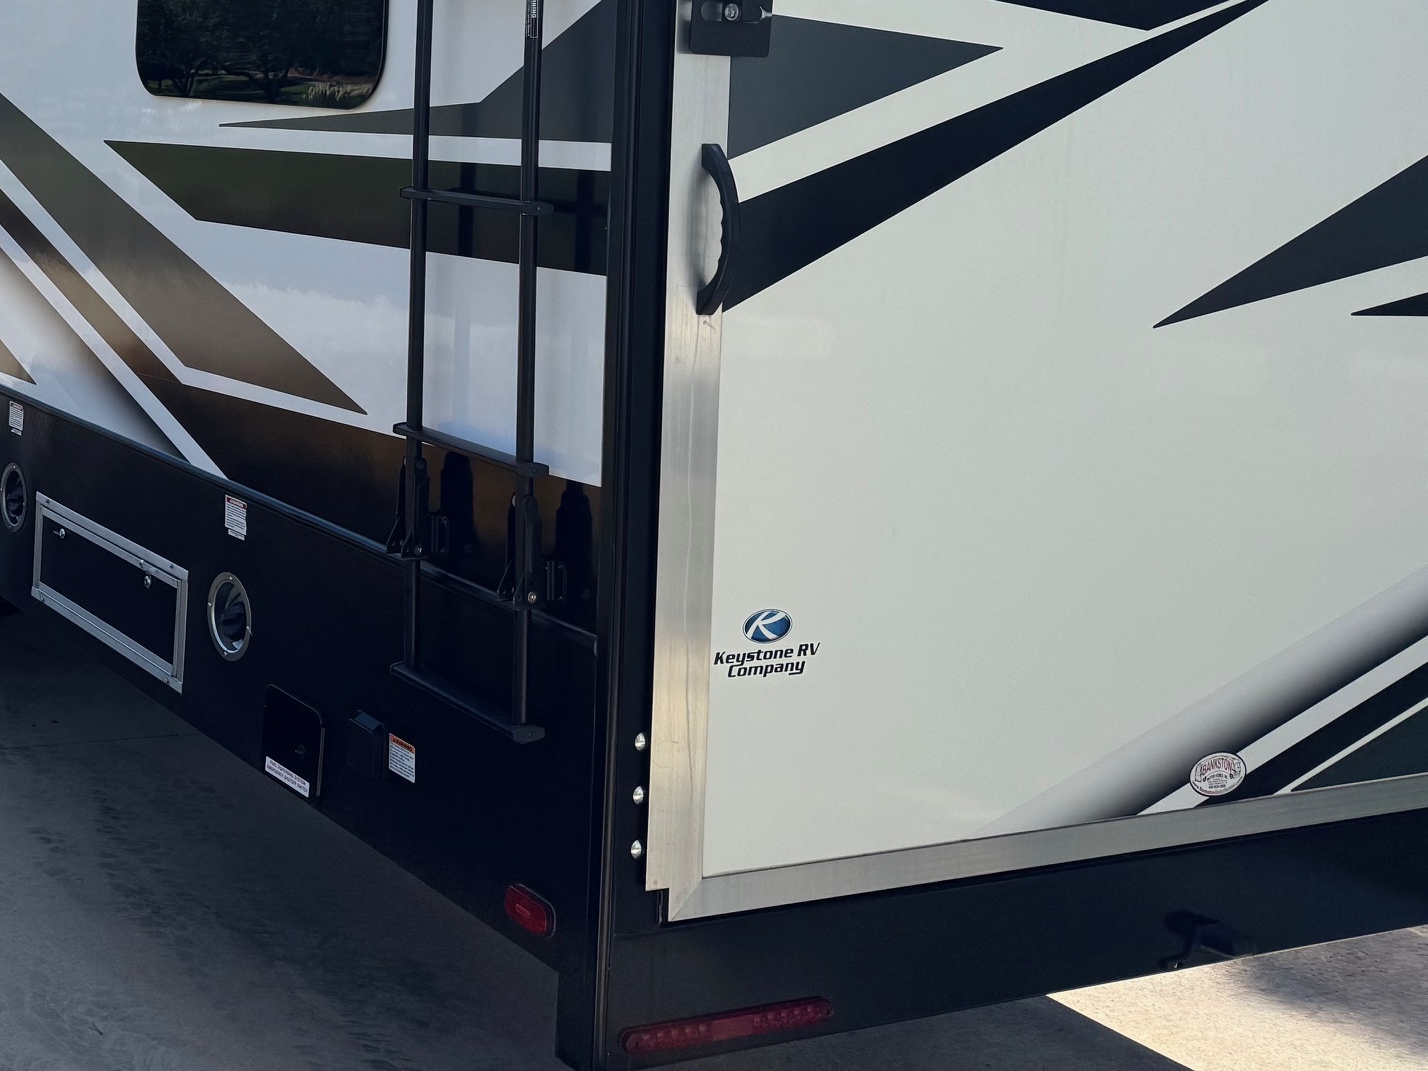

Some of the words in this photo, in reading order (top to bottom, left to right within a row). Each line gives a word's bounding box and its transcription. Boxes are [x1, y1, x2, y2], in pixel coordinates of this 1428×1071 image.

[713, 648, 794, 667] Keystone
[797, 642, 821, 657] RV
[727, 660, 806, 678] Company
